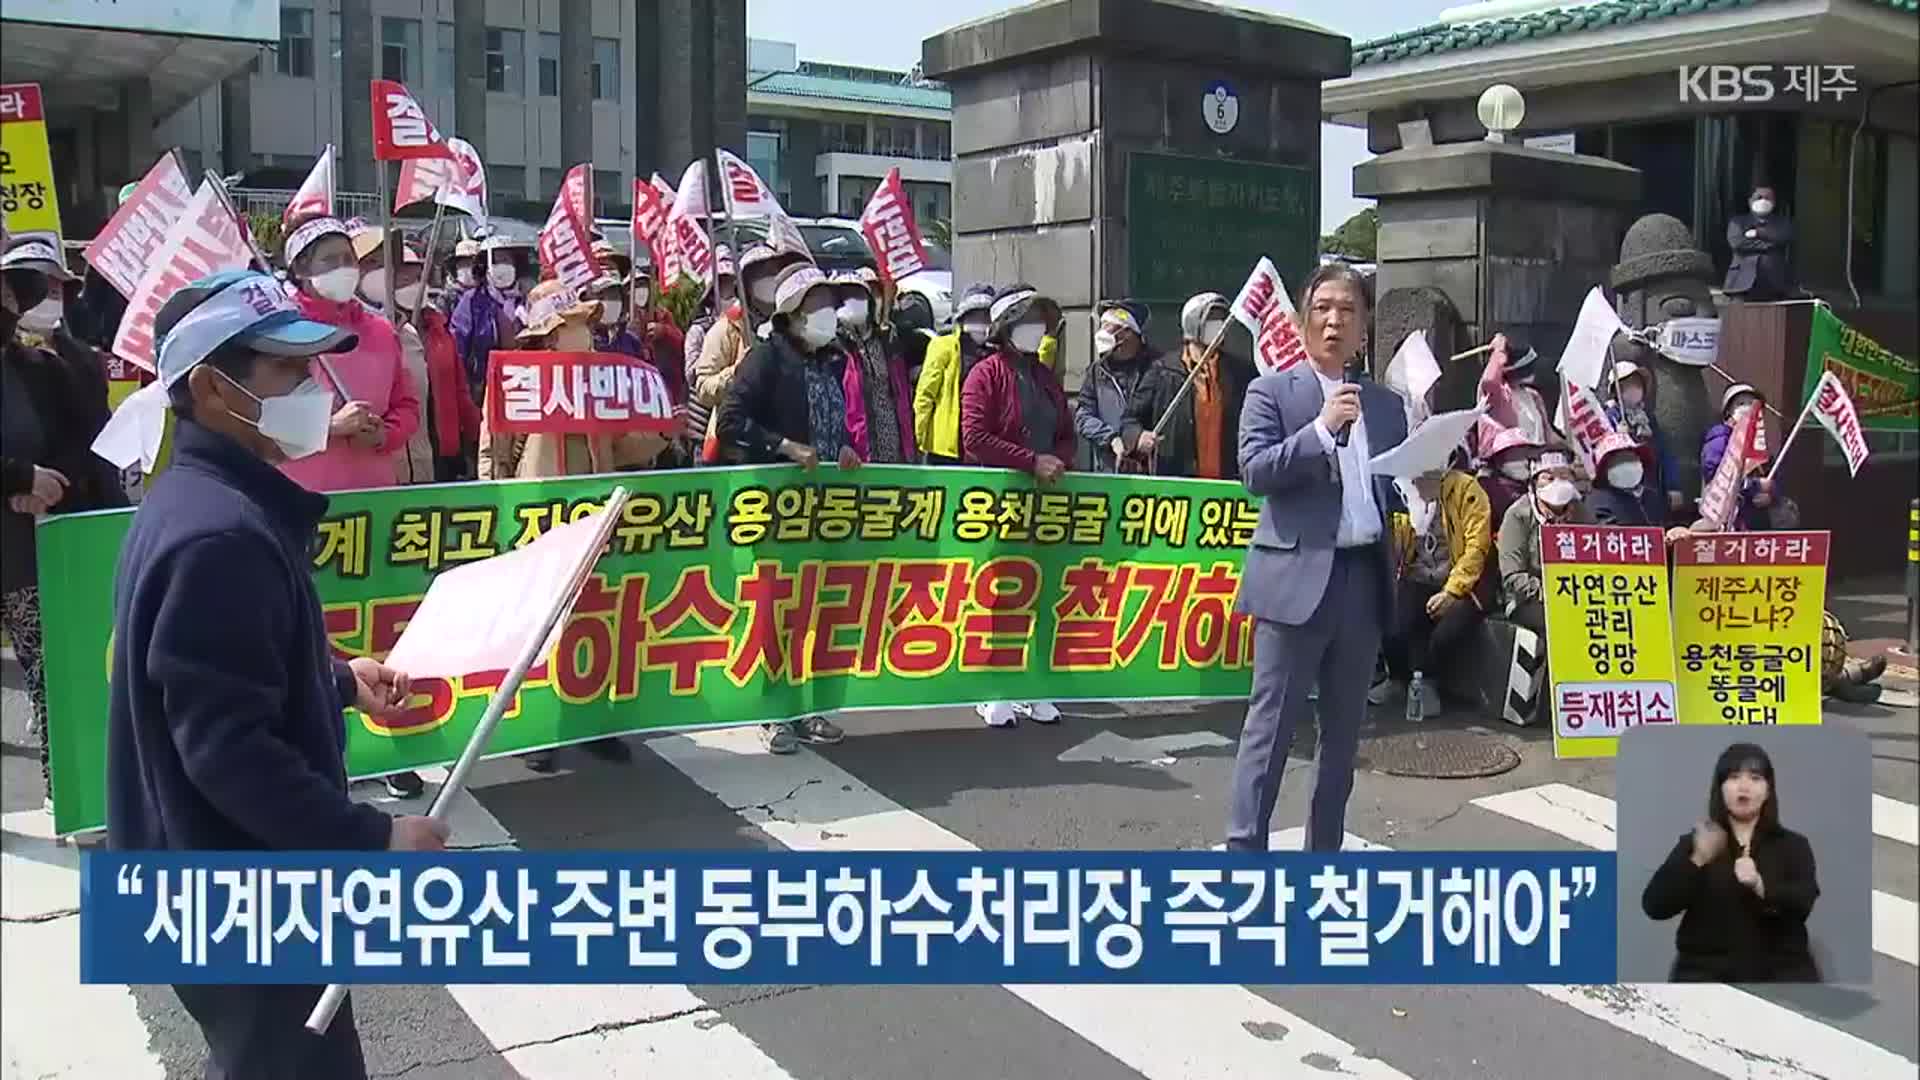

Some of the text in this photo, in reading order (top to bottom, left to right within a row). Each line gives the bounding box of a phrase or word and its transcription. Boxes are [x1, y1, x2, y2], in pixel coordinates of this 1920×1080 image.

[1671, 331, 1715, 349] 마스크
[501, 364, 672, 420] 결사반대
[391, 508, 494, 569] 최고
[728, 487, 943, 545] 용암동굴계
[956, 490, 1108, 541] 용천동굴
[1120, 497, 1189, 545] 위에
[1200, 500, 1260, 546] 있는
[1555, 532, 1653, 562] 철거하라
[1693, 538, 1812, 563] 철거하라
[1555, 574, 1658, 605] 자연유산
[1695, 576, 1802, 602] 제주시장
[1585, 609, 1634, 640] 관리
[1699, 605, 1795, 631] 아느냐?
[1588, 643, 1637, 675] 엉망
[1681, 644, 1812, 672] 용천동굴이
[1707, 675, 1785, 703] 똥물에
[1559, 691, 1673, 729] 등재취소
